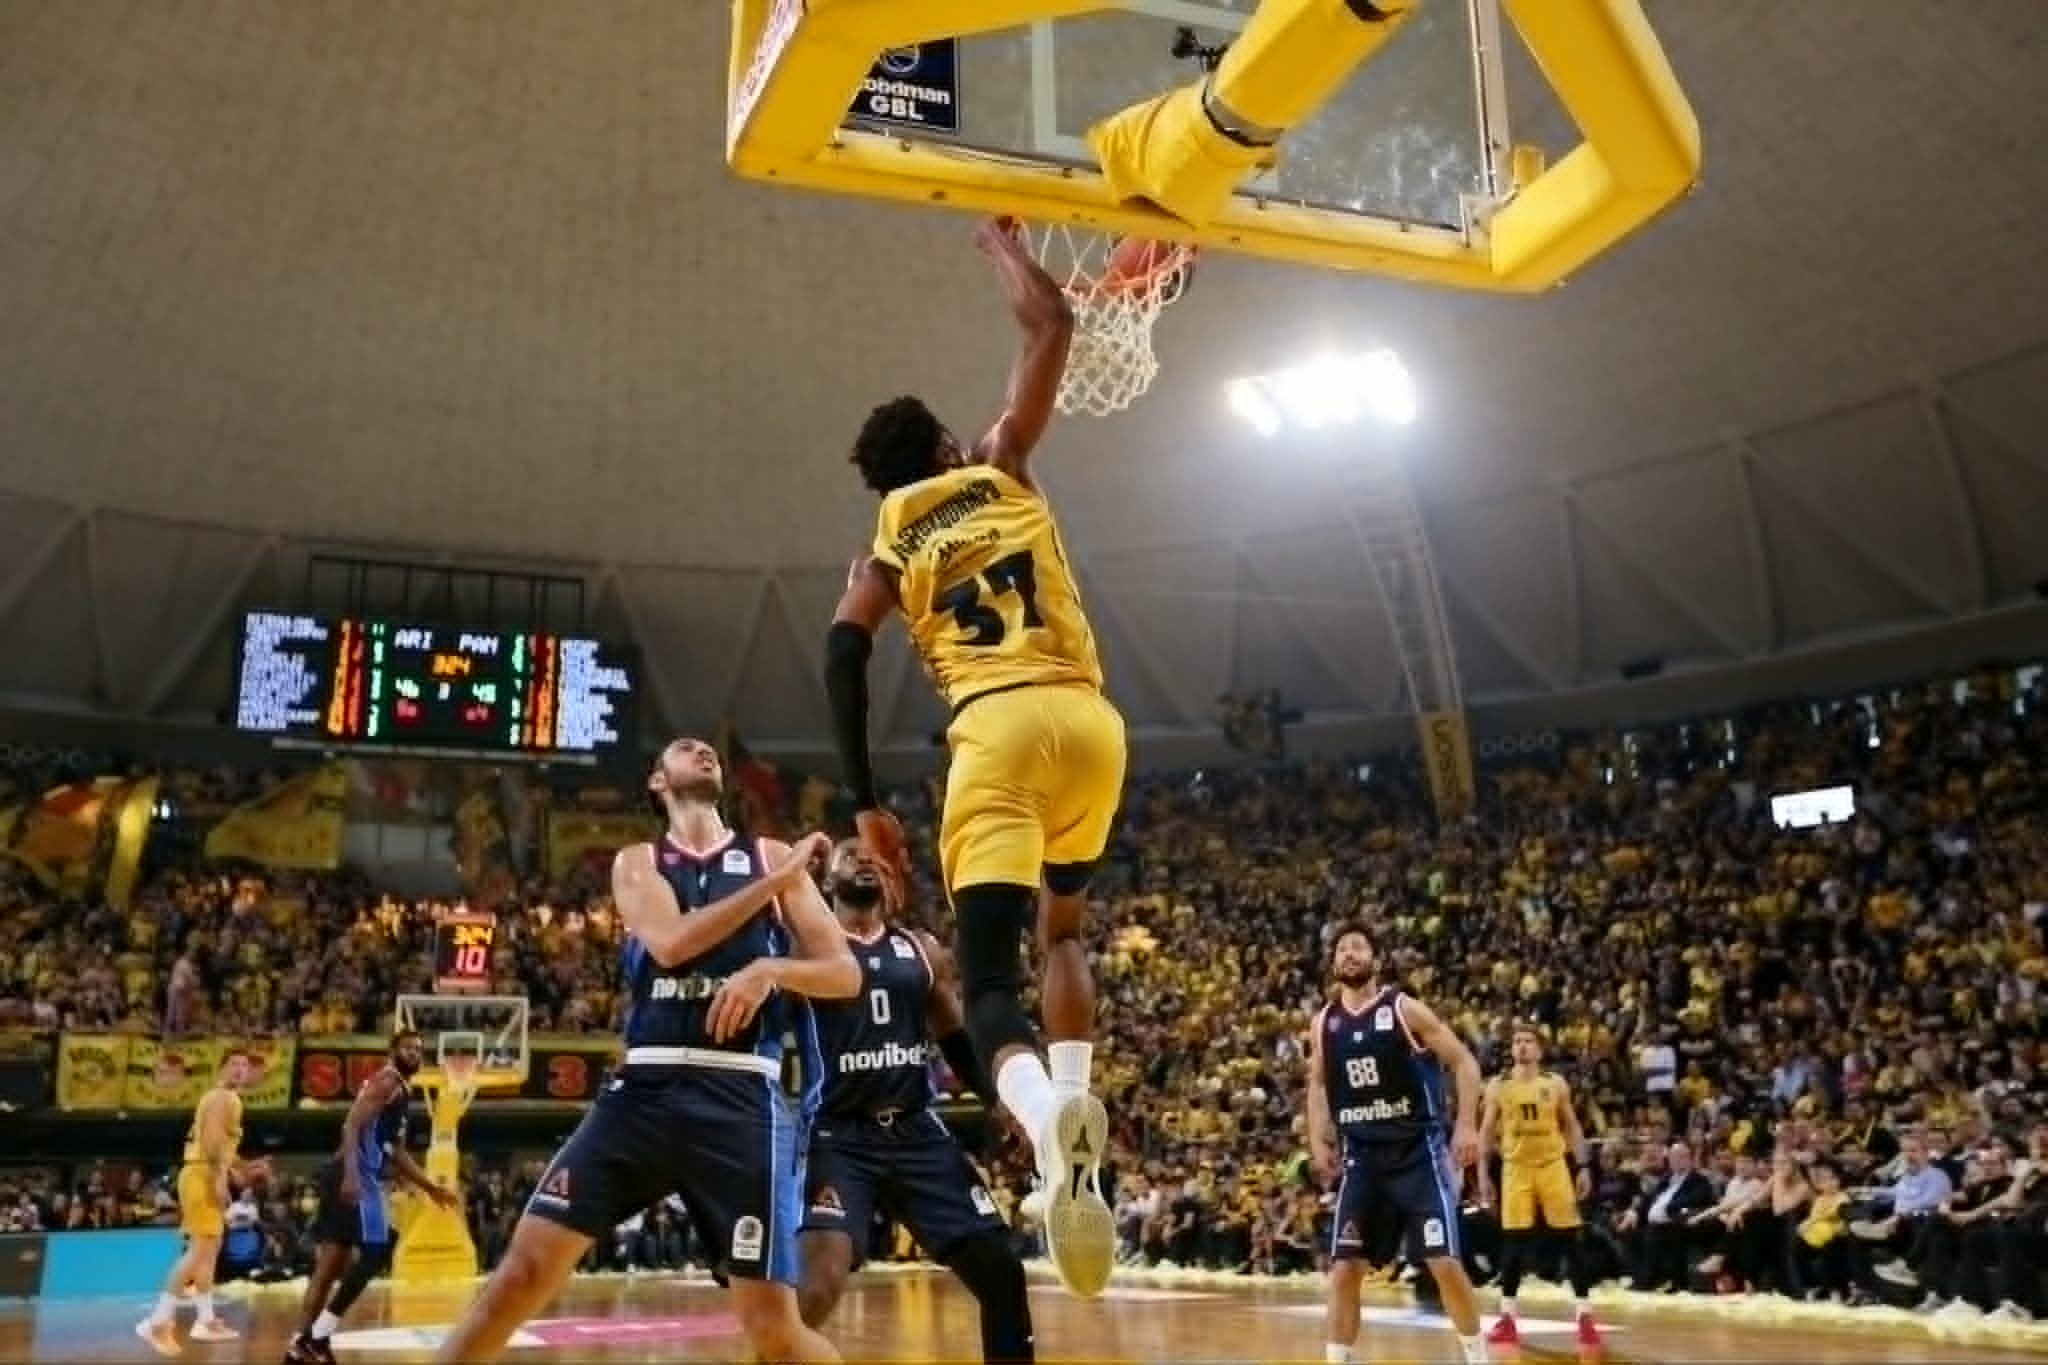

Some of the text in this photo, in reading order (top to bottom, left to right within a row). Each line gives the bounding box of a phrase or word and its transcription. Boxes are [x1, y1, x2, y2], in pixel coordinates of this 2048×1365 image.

[869, 95, 924, 121] GBL
[931, 548, 1045, 646] 37
[393, 628, 434, 651] ARI
[455, 946, 486, 974] 10
[870, 987, 891, 1025] 0
[1345, 1055, 1381, 1089] 88
[1338, 1096, 1411, 1125] novibet
[1519, 1103, 1539, 1121] 11
